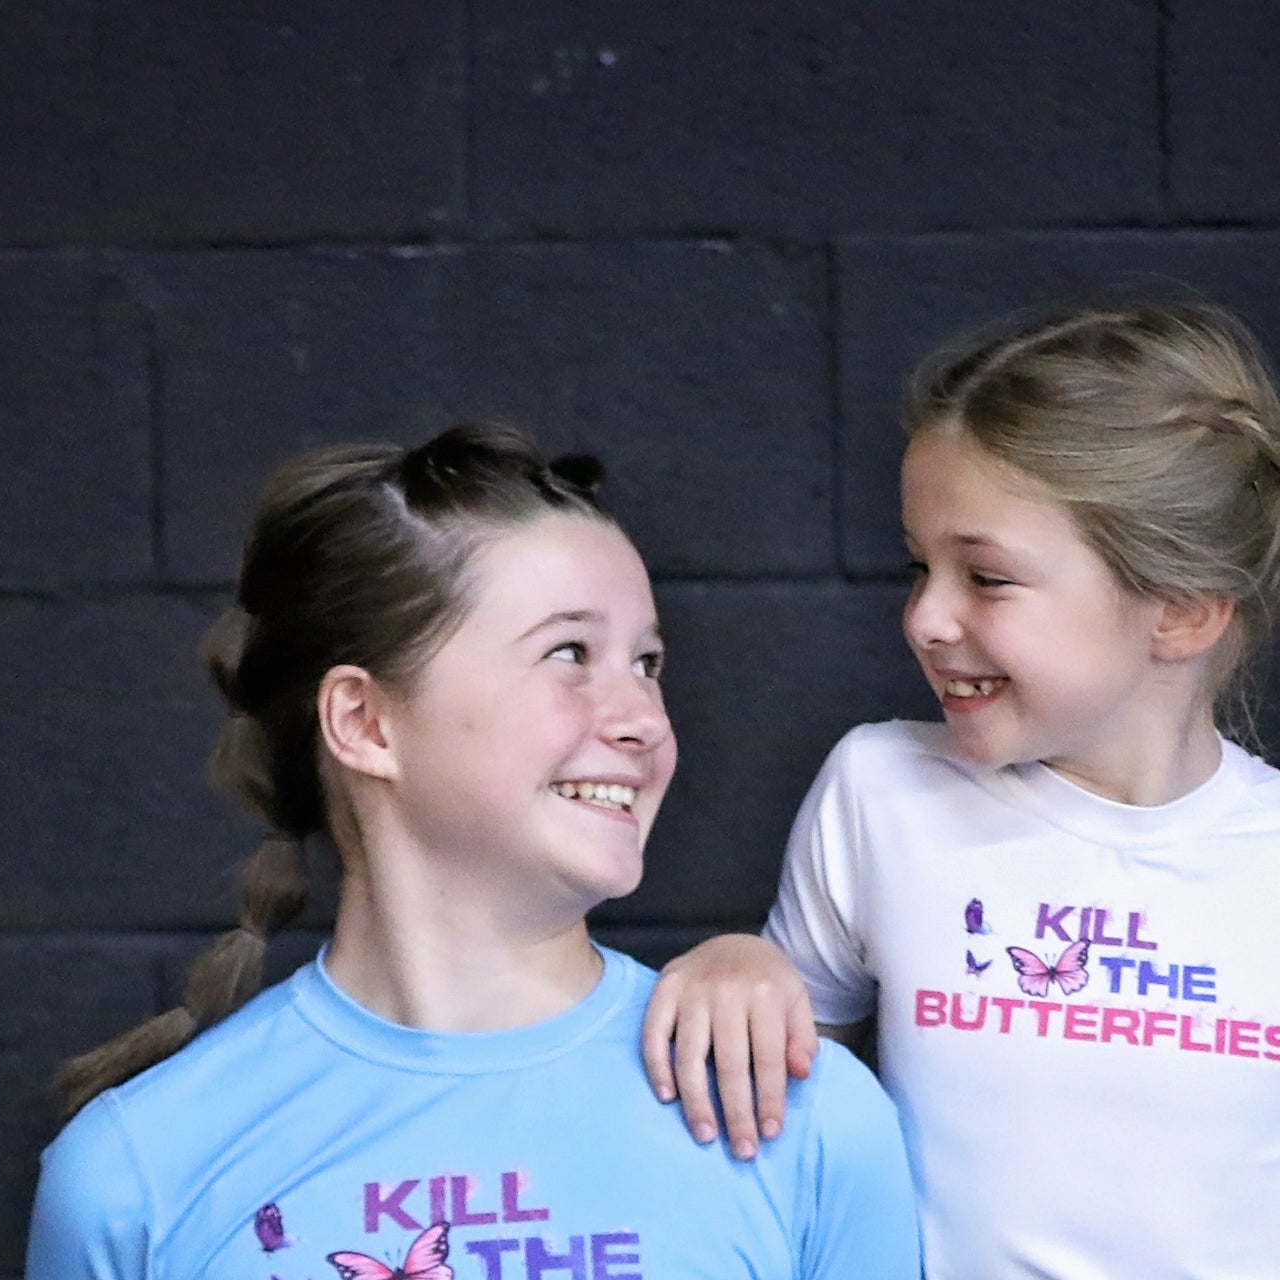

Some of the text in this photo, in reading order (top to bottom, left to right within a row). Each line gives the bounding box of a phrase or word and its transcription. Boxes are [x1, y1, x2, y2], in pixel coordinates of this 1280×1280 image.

[1034, 903, 1158, 950] KILL
[1099, 956, 1217, 1003] THE
[363, 1171, 550, 1233] KILL
